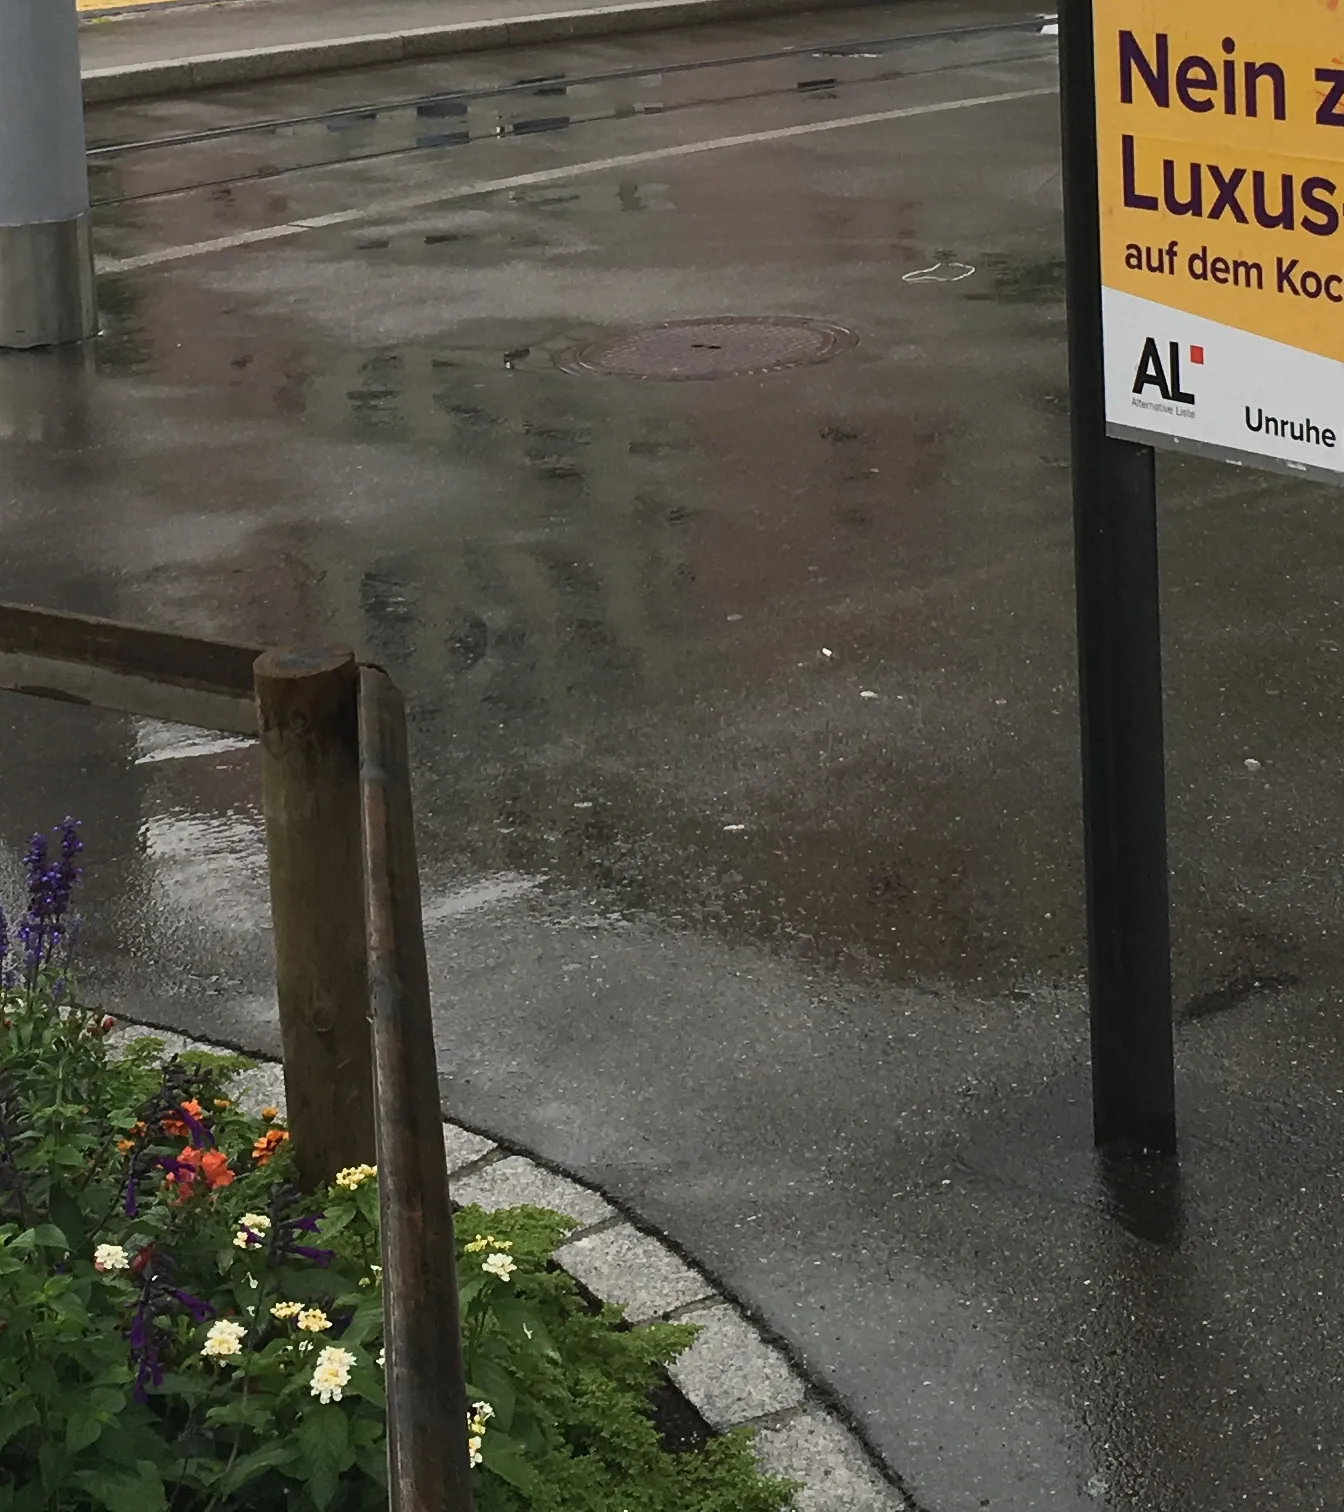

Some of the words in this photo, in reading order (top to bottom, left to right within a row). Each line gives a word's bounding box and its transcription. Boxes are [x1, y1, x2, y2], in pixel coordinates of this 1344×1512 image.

[1118, 29, 1286, 121] Nein
[1124, 240, 1179, 276] auf
[1187, 245, 1264, 290] dem
[1132, 336, 1195, 405] AL
[1245, 405, 1336, 448] Unruhe
